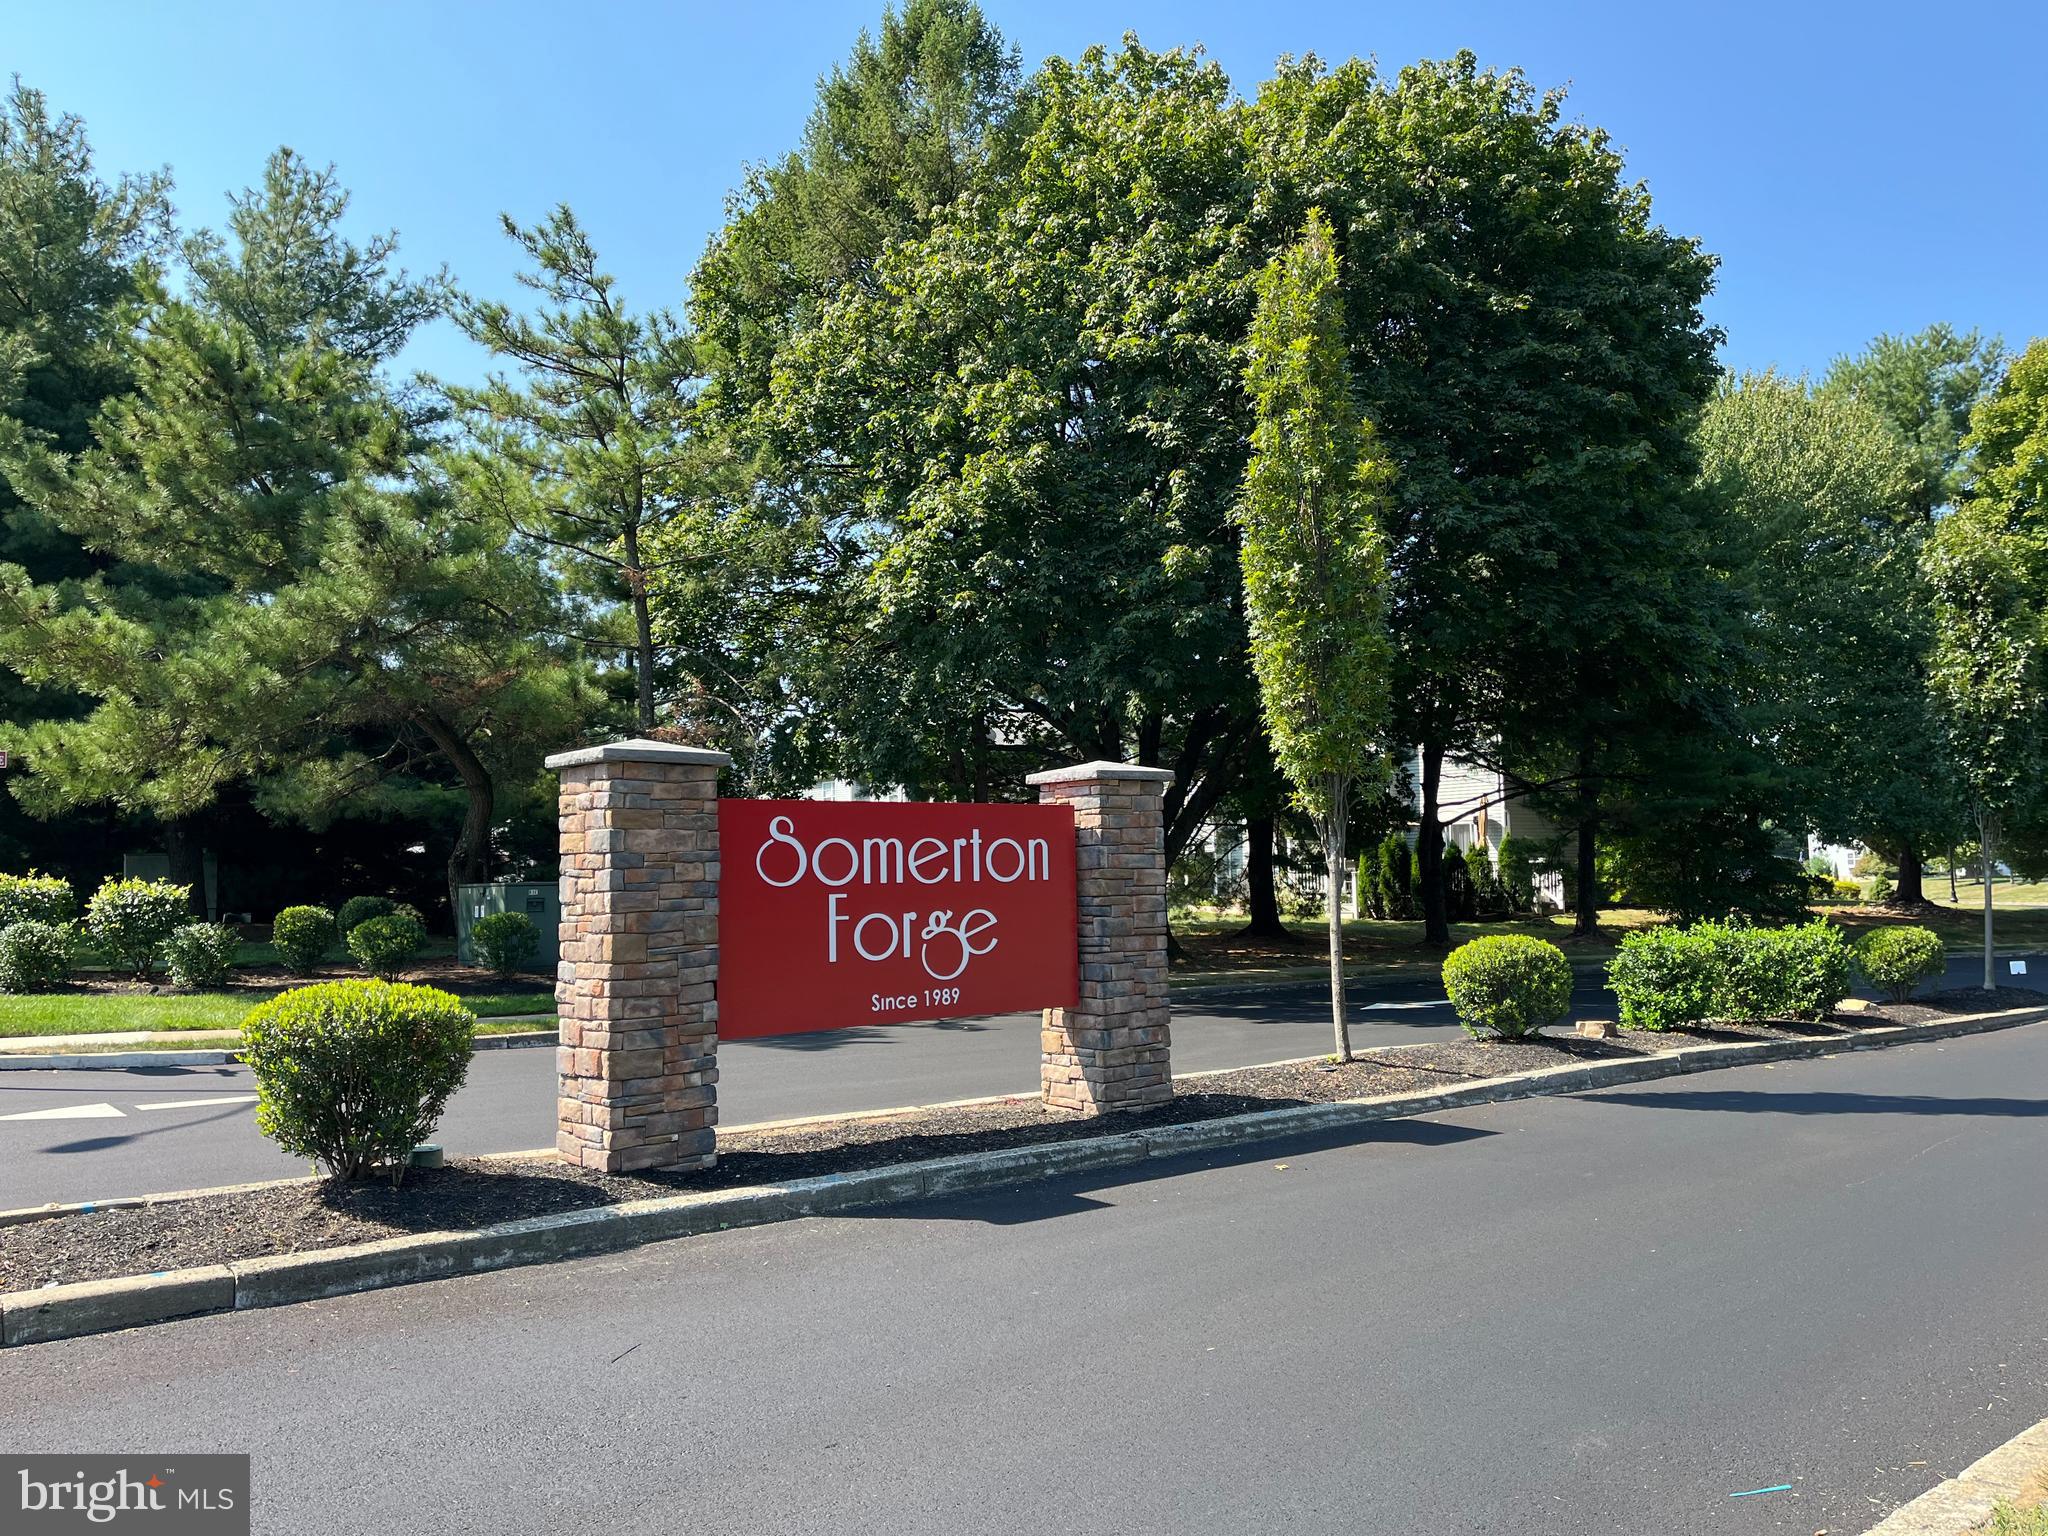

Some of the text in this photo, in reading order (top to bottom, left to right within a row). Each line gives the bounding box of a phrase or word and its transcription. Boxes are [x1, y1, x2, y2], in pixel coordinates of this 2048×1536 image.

[755, 815, 1049, 887] Somerton
[828, 893, 998, 981] Forge
[871, 987, 960, 1012] Since 1989
